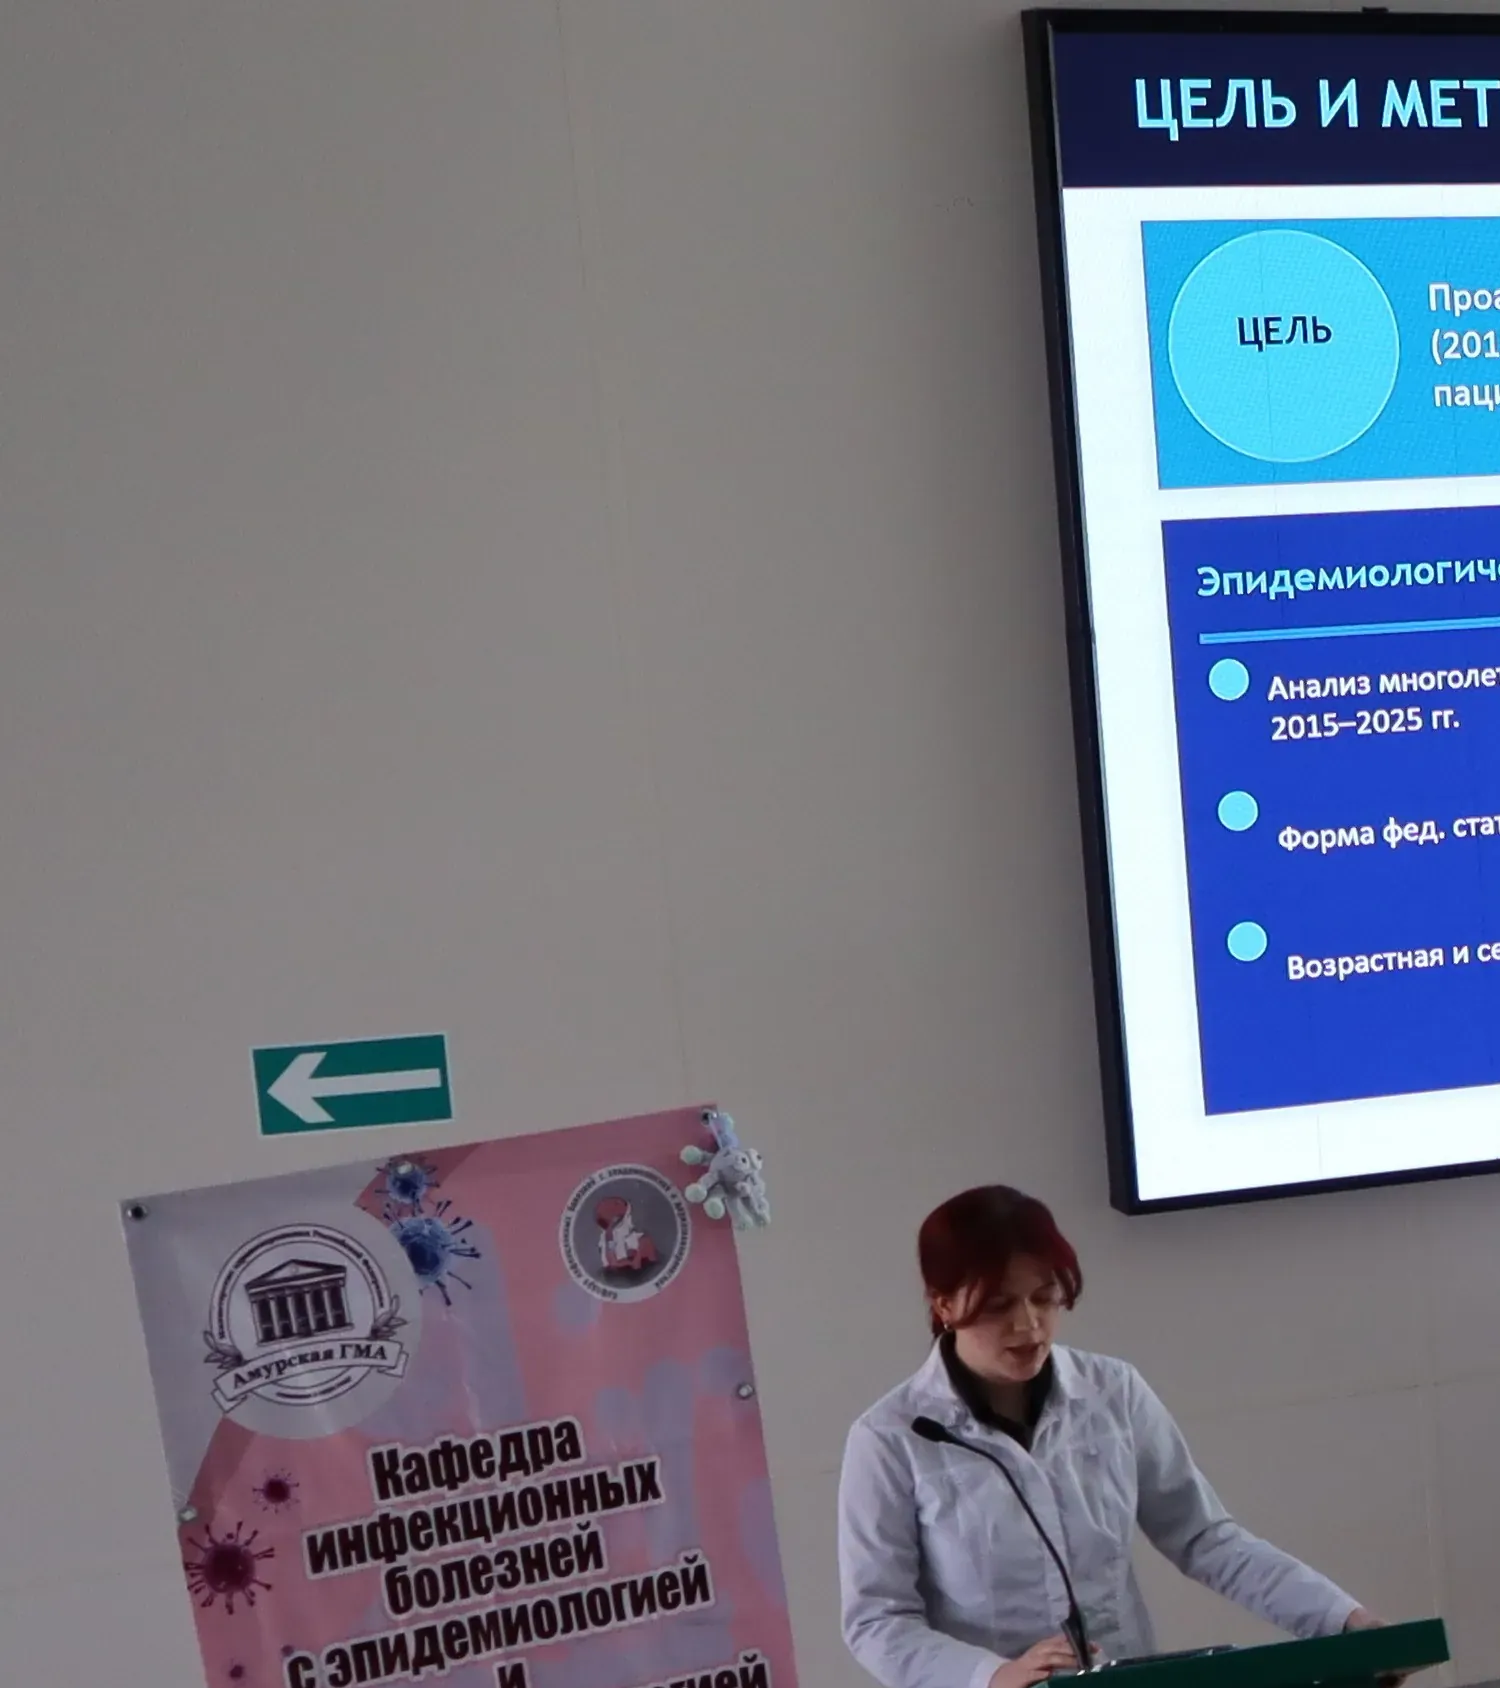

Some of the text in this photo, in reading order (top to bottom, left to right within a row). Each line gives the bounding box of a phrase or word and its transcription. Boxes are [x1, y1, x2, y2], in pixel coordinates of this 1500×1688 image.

[1135, 78, 1297, 142] ЦЕЛЬ
[1319, 78, 1359, 128] И
[1237, 315, 1332, 353] ЦЕЛЬ
[1267, 675, 1371, 701] Анализ
[1431, 709, 1460, 730] гг.
[1278, 825, 1375, 855] Форма
[1382, 816, 1446, 849] фед.
[1287, 947, 1444, 982] Возрастная
[1452, 945, 1469, 965] и
[233, 1348, 333, 1389] Амурская
[340, 1344, 388, 1360] ГМА
[373, 1420, 581, 1500] Кафедра
[307, 1462, 662, 1574] инфекционных
[386, 1524, 604, 1615] болезней
[327, 1558, 710, 1688] эпидемиологией
